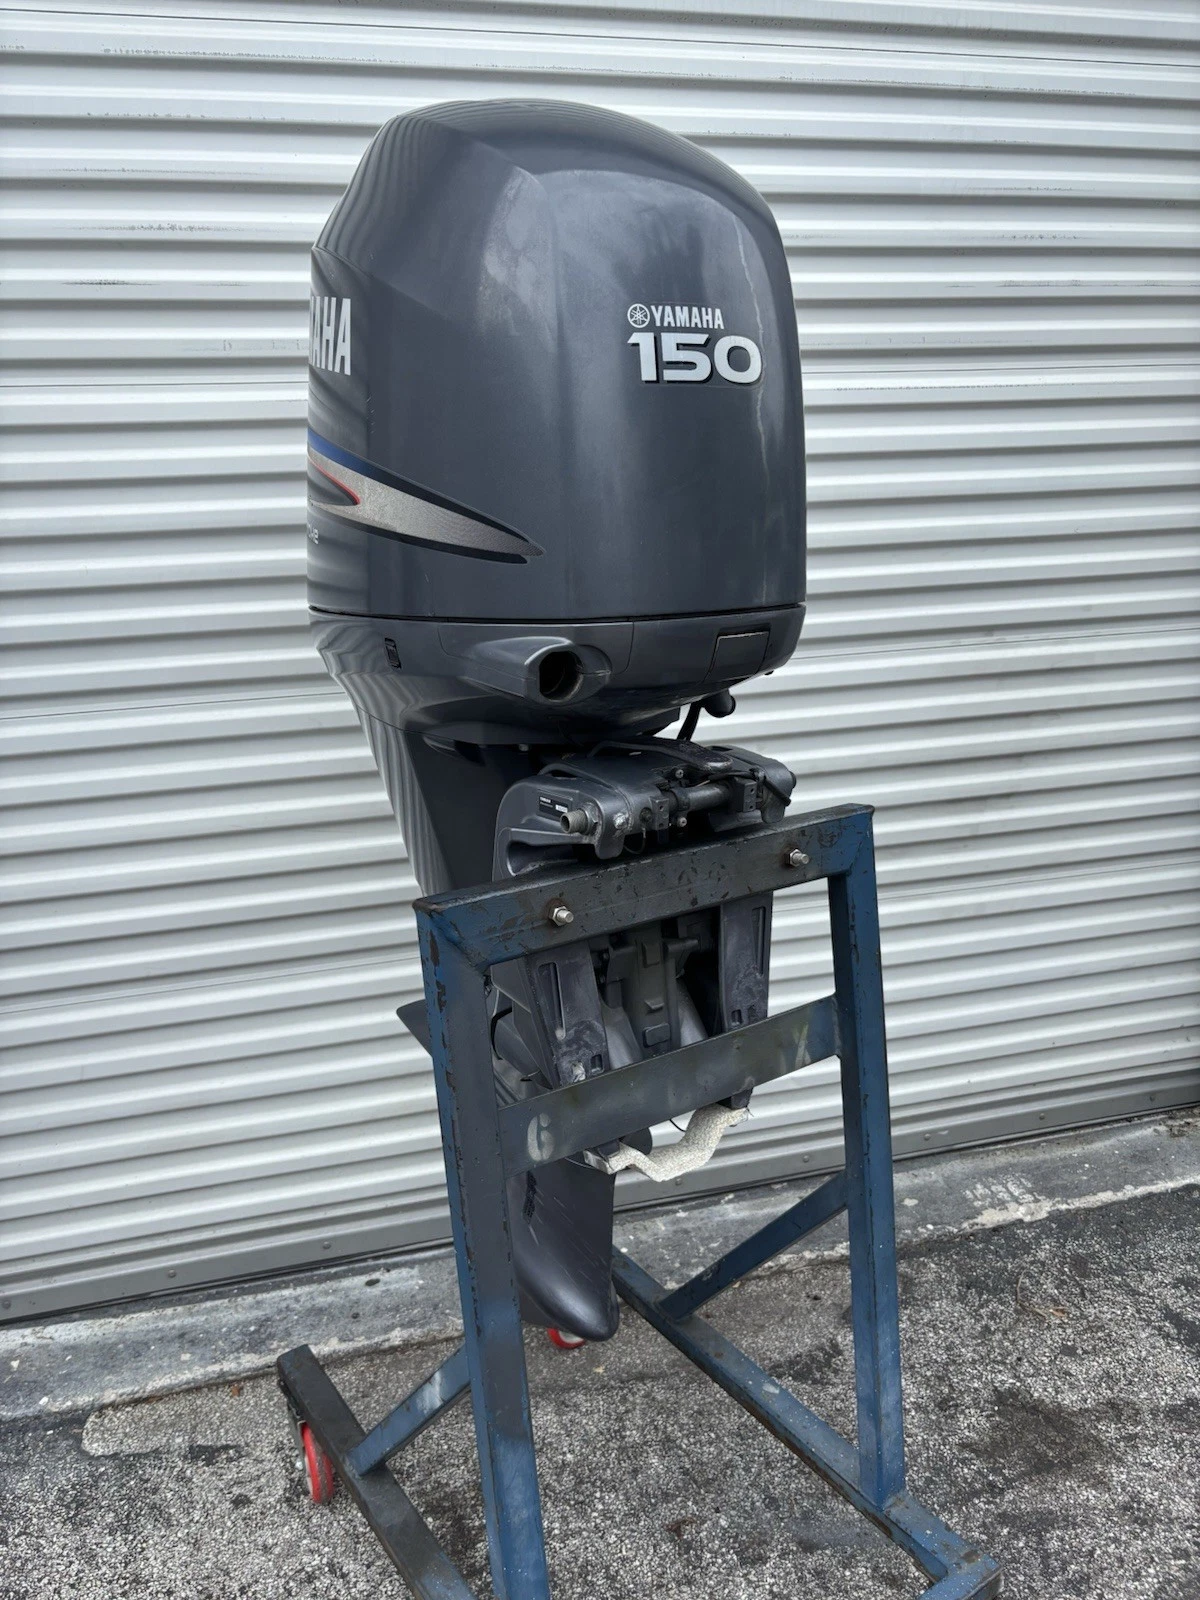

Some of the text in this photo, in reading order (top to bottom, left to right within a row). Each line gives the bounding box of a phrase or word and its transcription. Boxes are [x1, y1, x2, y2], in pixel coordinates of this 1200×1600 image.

[310, 295, 352, 376] AHA
[650, 305, 725, 330] YAMAHA
[627, 331, 763, 385] 150
